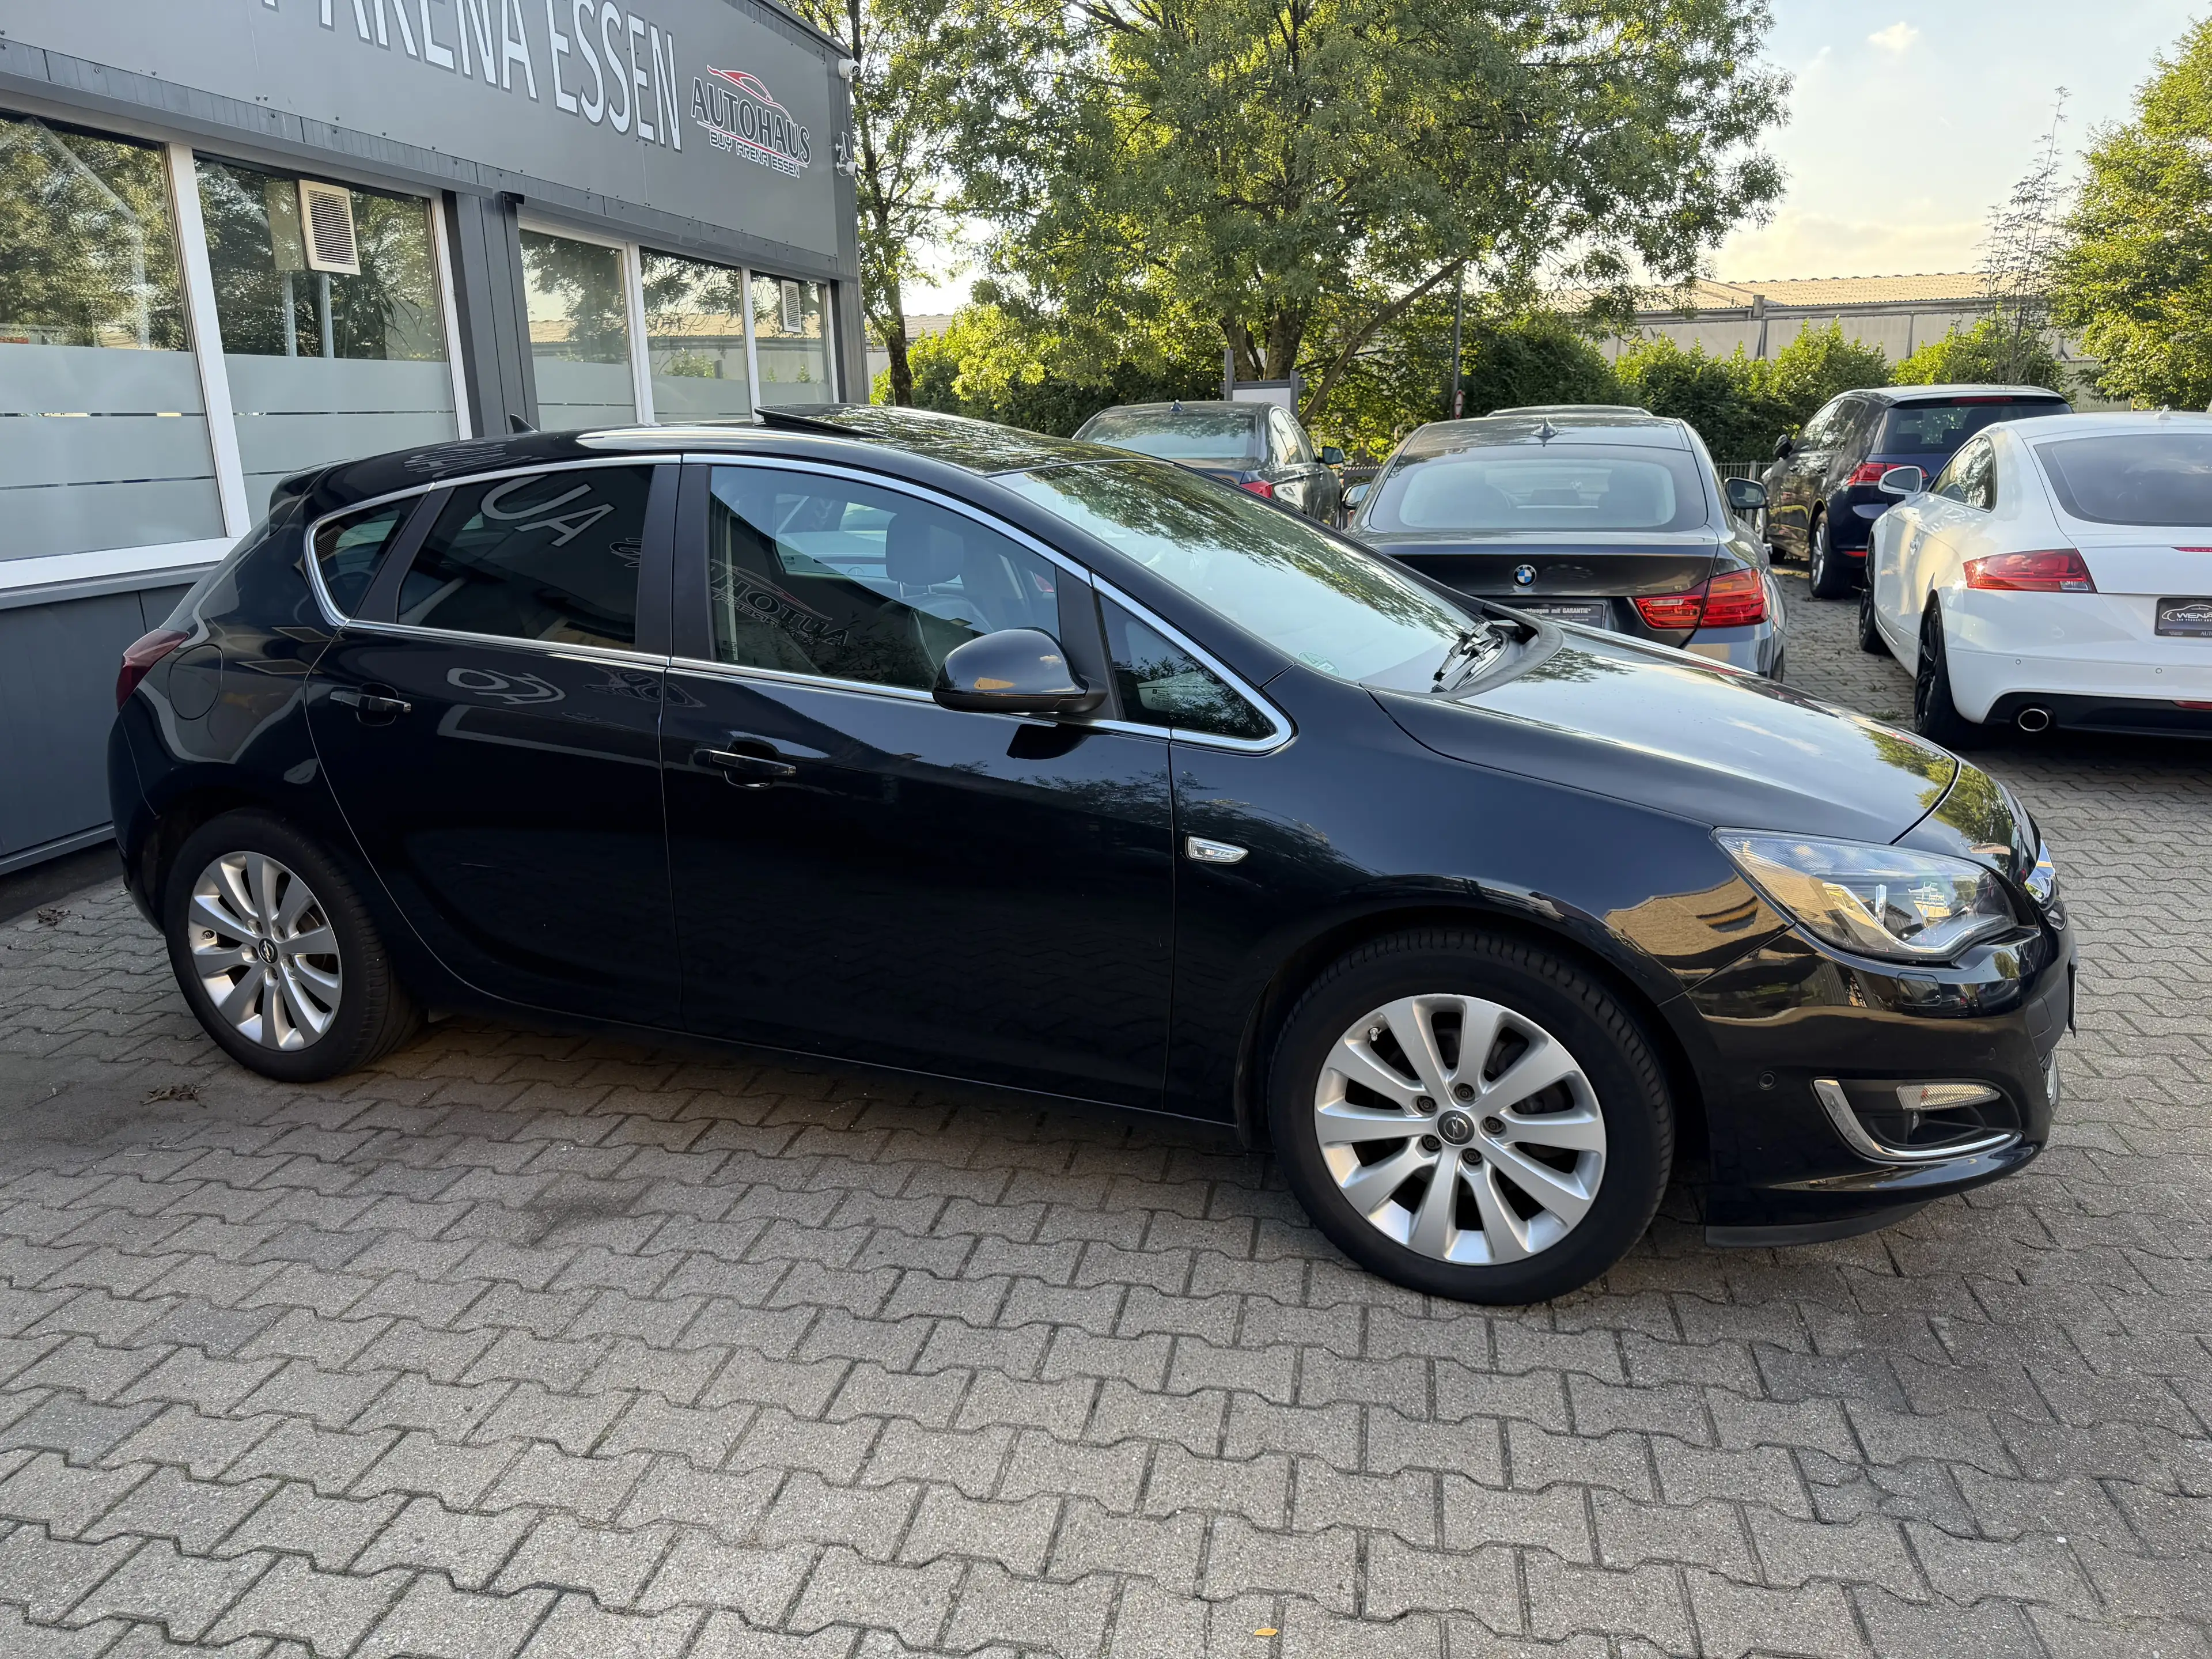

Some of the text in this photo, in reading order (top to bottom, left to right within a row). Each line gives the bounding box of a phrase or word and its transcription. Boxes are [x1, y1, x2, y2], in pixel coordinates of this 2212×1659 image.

[320, 0, 681, 151] ENA ESSEN
[691, 77, 811, 164] AUTOHAUS
[709, 130, 800, 179] BUY ARENA ESSEN
